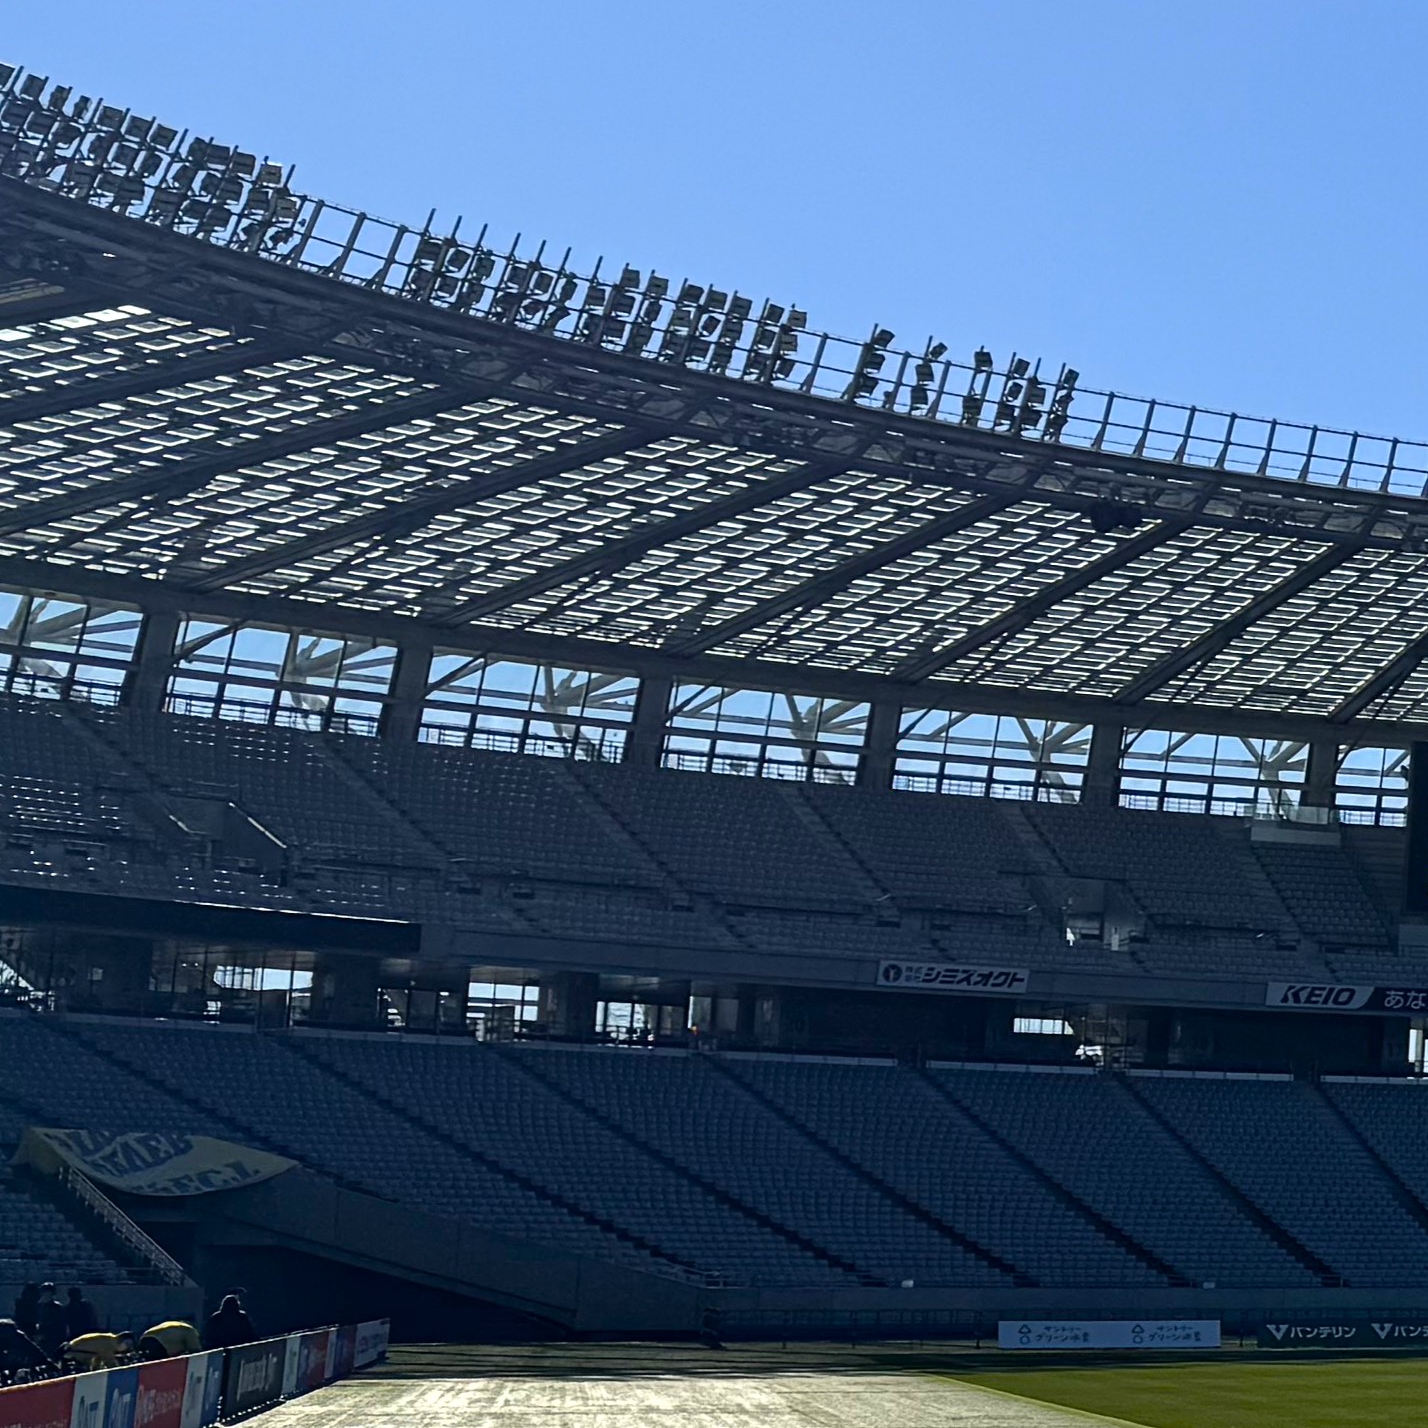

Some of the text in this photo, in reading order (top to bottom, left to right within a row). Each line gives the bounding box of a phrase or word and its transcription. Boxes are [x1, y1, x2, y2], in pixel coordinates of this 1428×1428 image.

[922, 967, 1025, 988] シミズオクト
[1280, 985, 1356, 1005] KEIO
